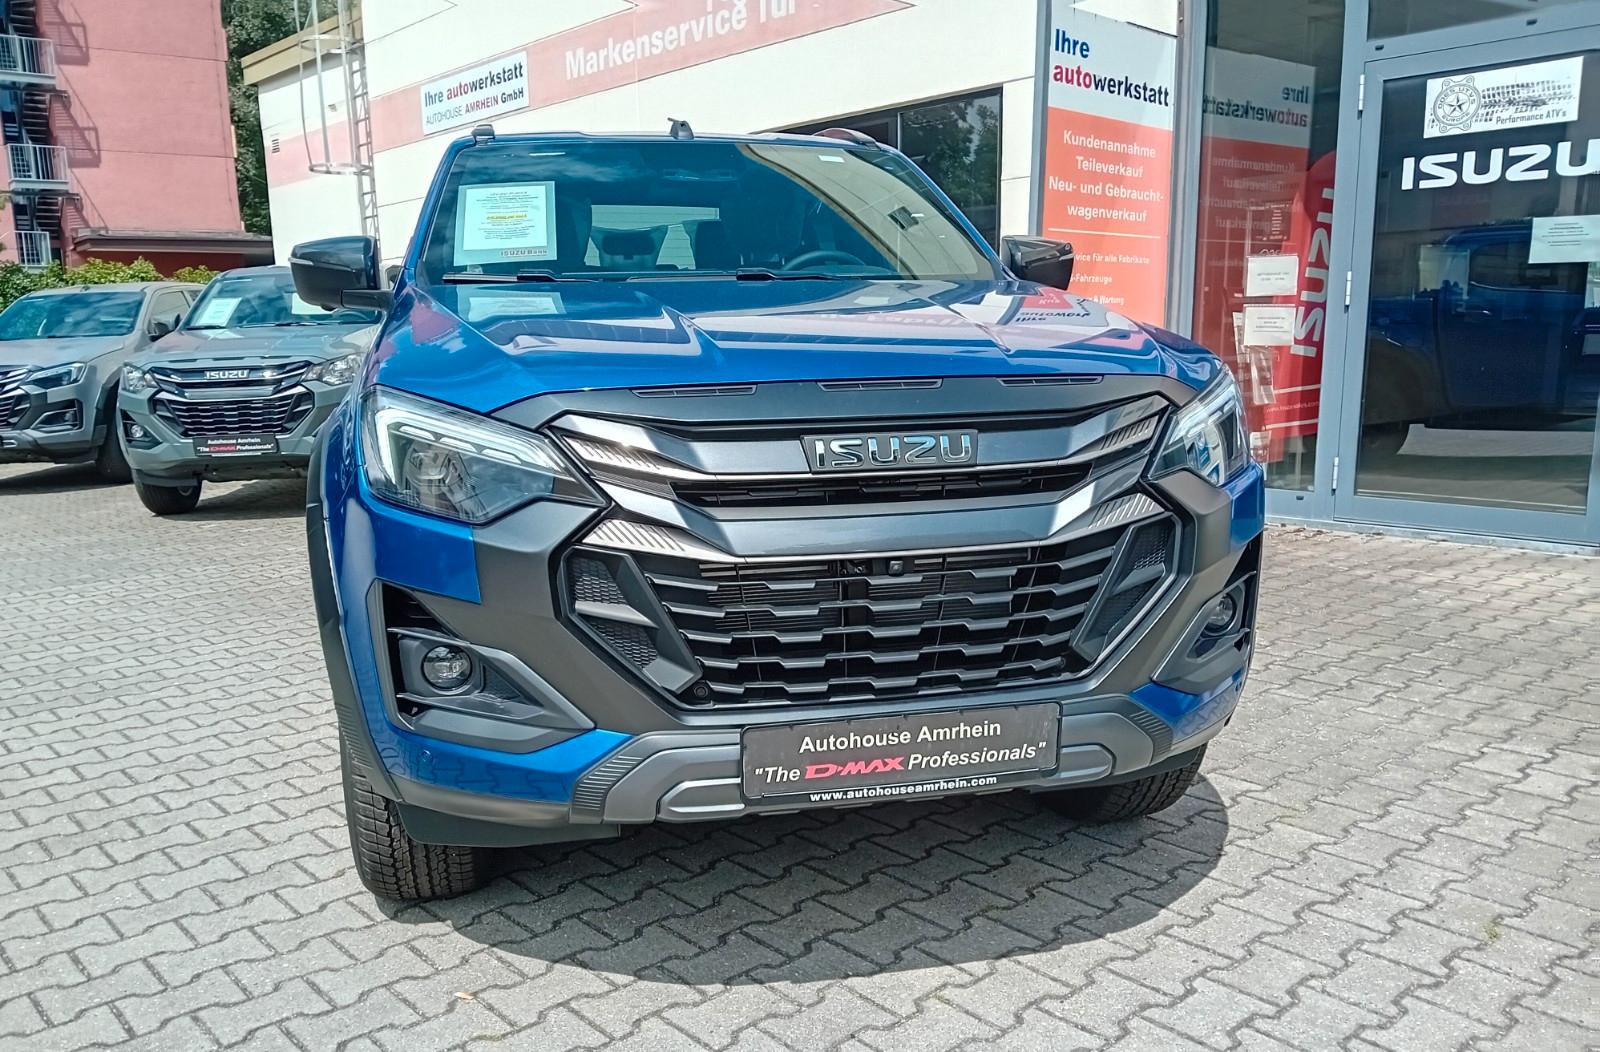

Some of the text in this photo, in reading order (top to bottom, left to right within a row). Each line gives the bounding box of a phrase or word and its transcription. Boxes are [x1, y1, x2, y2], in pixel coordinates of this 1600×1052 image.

[565, 5, 747, 80] Markenservice
[1055, 28, 1090, 59] Ihre
[424, 61, 523, 107] Ihre autowerkstatt
[1053, 64, 1169, 107] autowerkstatt
[426, 87, 524, 125] AUTOHOUSE AMRHEIN GmbH
[1496, 113, 1544, 125] Performance
[1063, 129, 1157, 158] Kundenannahme
[1075, 155, 1144, 178] Teileverkauf
[1401, 139, 1600, 191] ISUZU
[1049, 175, 1164, 202] Neu- und Gebraucht-
[1067, 205, 1148, 222] wagenverkauf
[205, 370, 249, 380] ISUZU
[815, 434, 972, 468] ISUZU
[799, 720, 1001, 754] Autohouse Amrhein
[754, 765, 801, 784] "The
[907, 741, 1047, 770] Professionals"
[809, 776, 998, 802] www.autohouseamrhein.com
